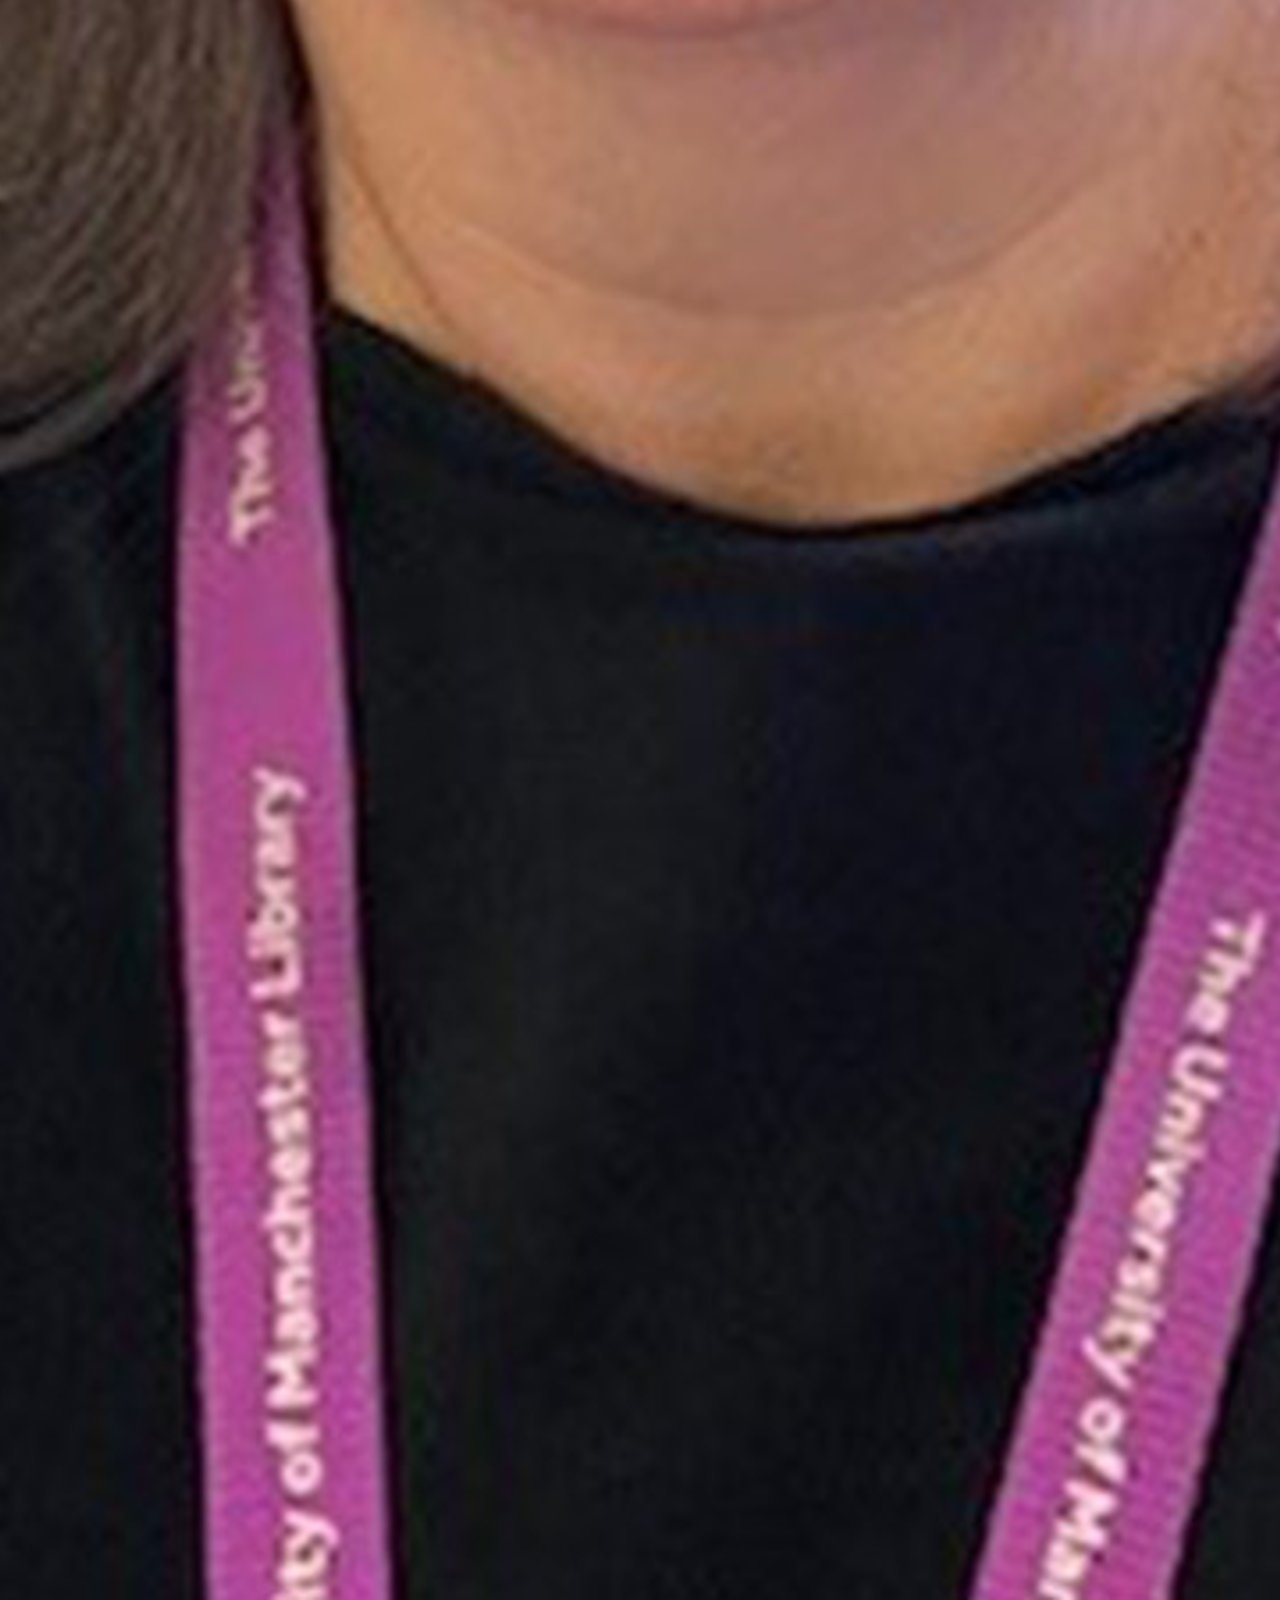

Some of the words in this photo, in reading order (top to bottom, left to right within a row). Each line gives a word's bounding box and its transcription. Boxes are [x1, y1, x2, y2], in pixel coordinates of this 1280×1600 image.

[225, 425, 277, 547] The
[248, 766, 306, 1001] Library
[1187, 907, 1266, 1033] The
[257, 1009, 320, 1410] Manchester
[1082, 1043, 1229, 1390] University
[267, 1406, 326, 1494] of
[1074, 1397, 1128, 1484] of
